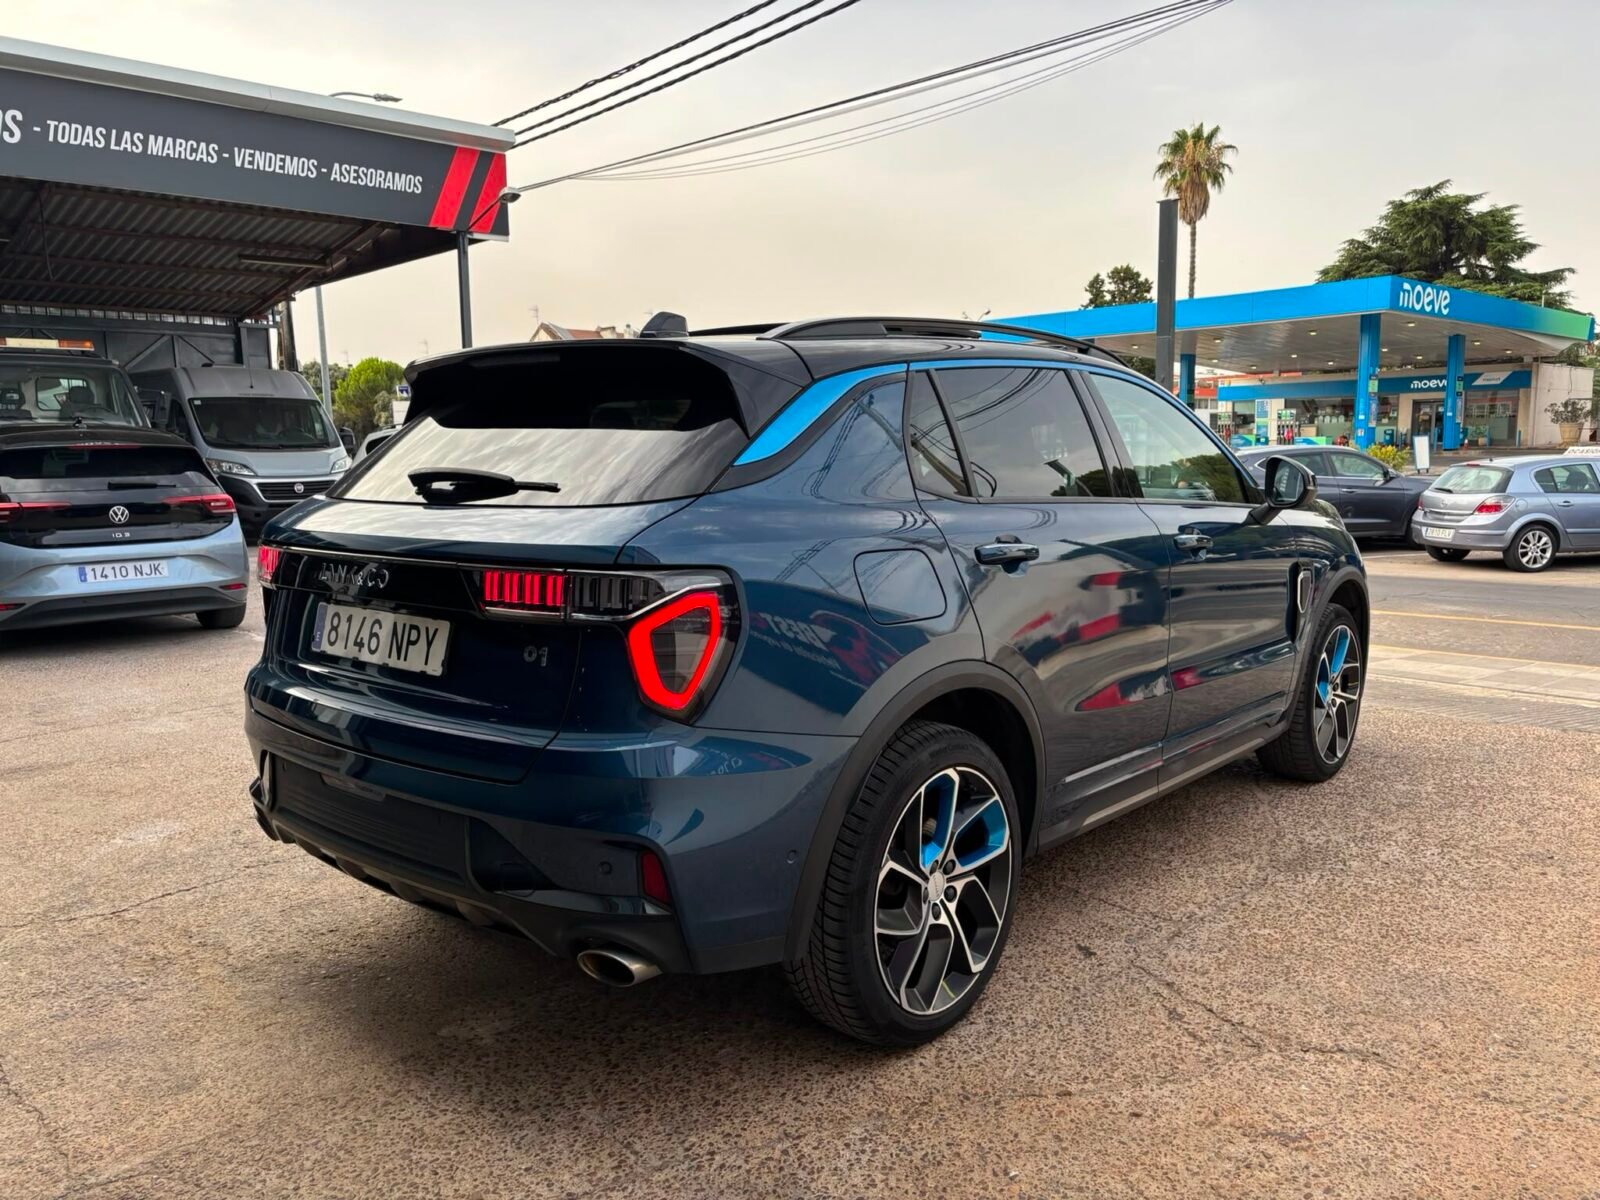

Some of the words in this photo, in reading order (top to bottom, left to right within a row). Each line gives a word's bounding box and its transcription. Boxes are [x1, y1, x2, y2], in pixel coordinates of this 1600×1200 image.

[0, 109, 23, 144] S
[46, 120, 107, 148] TODAS
[110, 129, 144, 153] LAS
[147, 134, 219, 164] MARCAS
[233, 147, 318, 178] VENDEMOS
[330, 163, 423, 194] ASESORAMOS
[1399, 282, 1450, 315] moeve
[91, 565, 129, 581] 1410
[133, 562, 163, 577] NJK
[327, 611, 382, 655] 8146
[388, 621, 439, 666] NPY
[523, 646, 548, 667] 01
